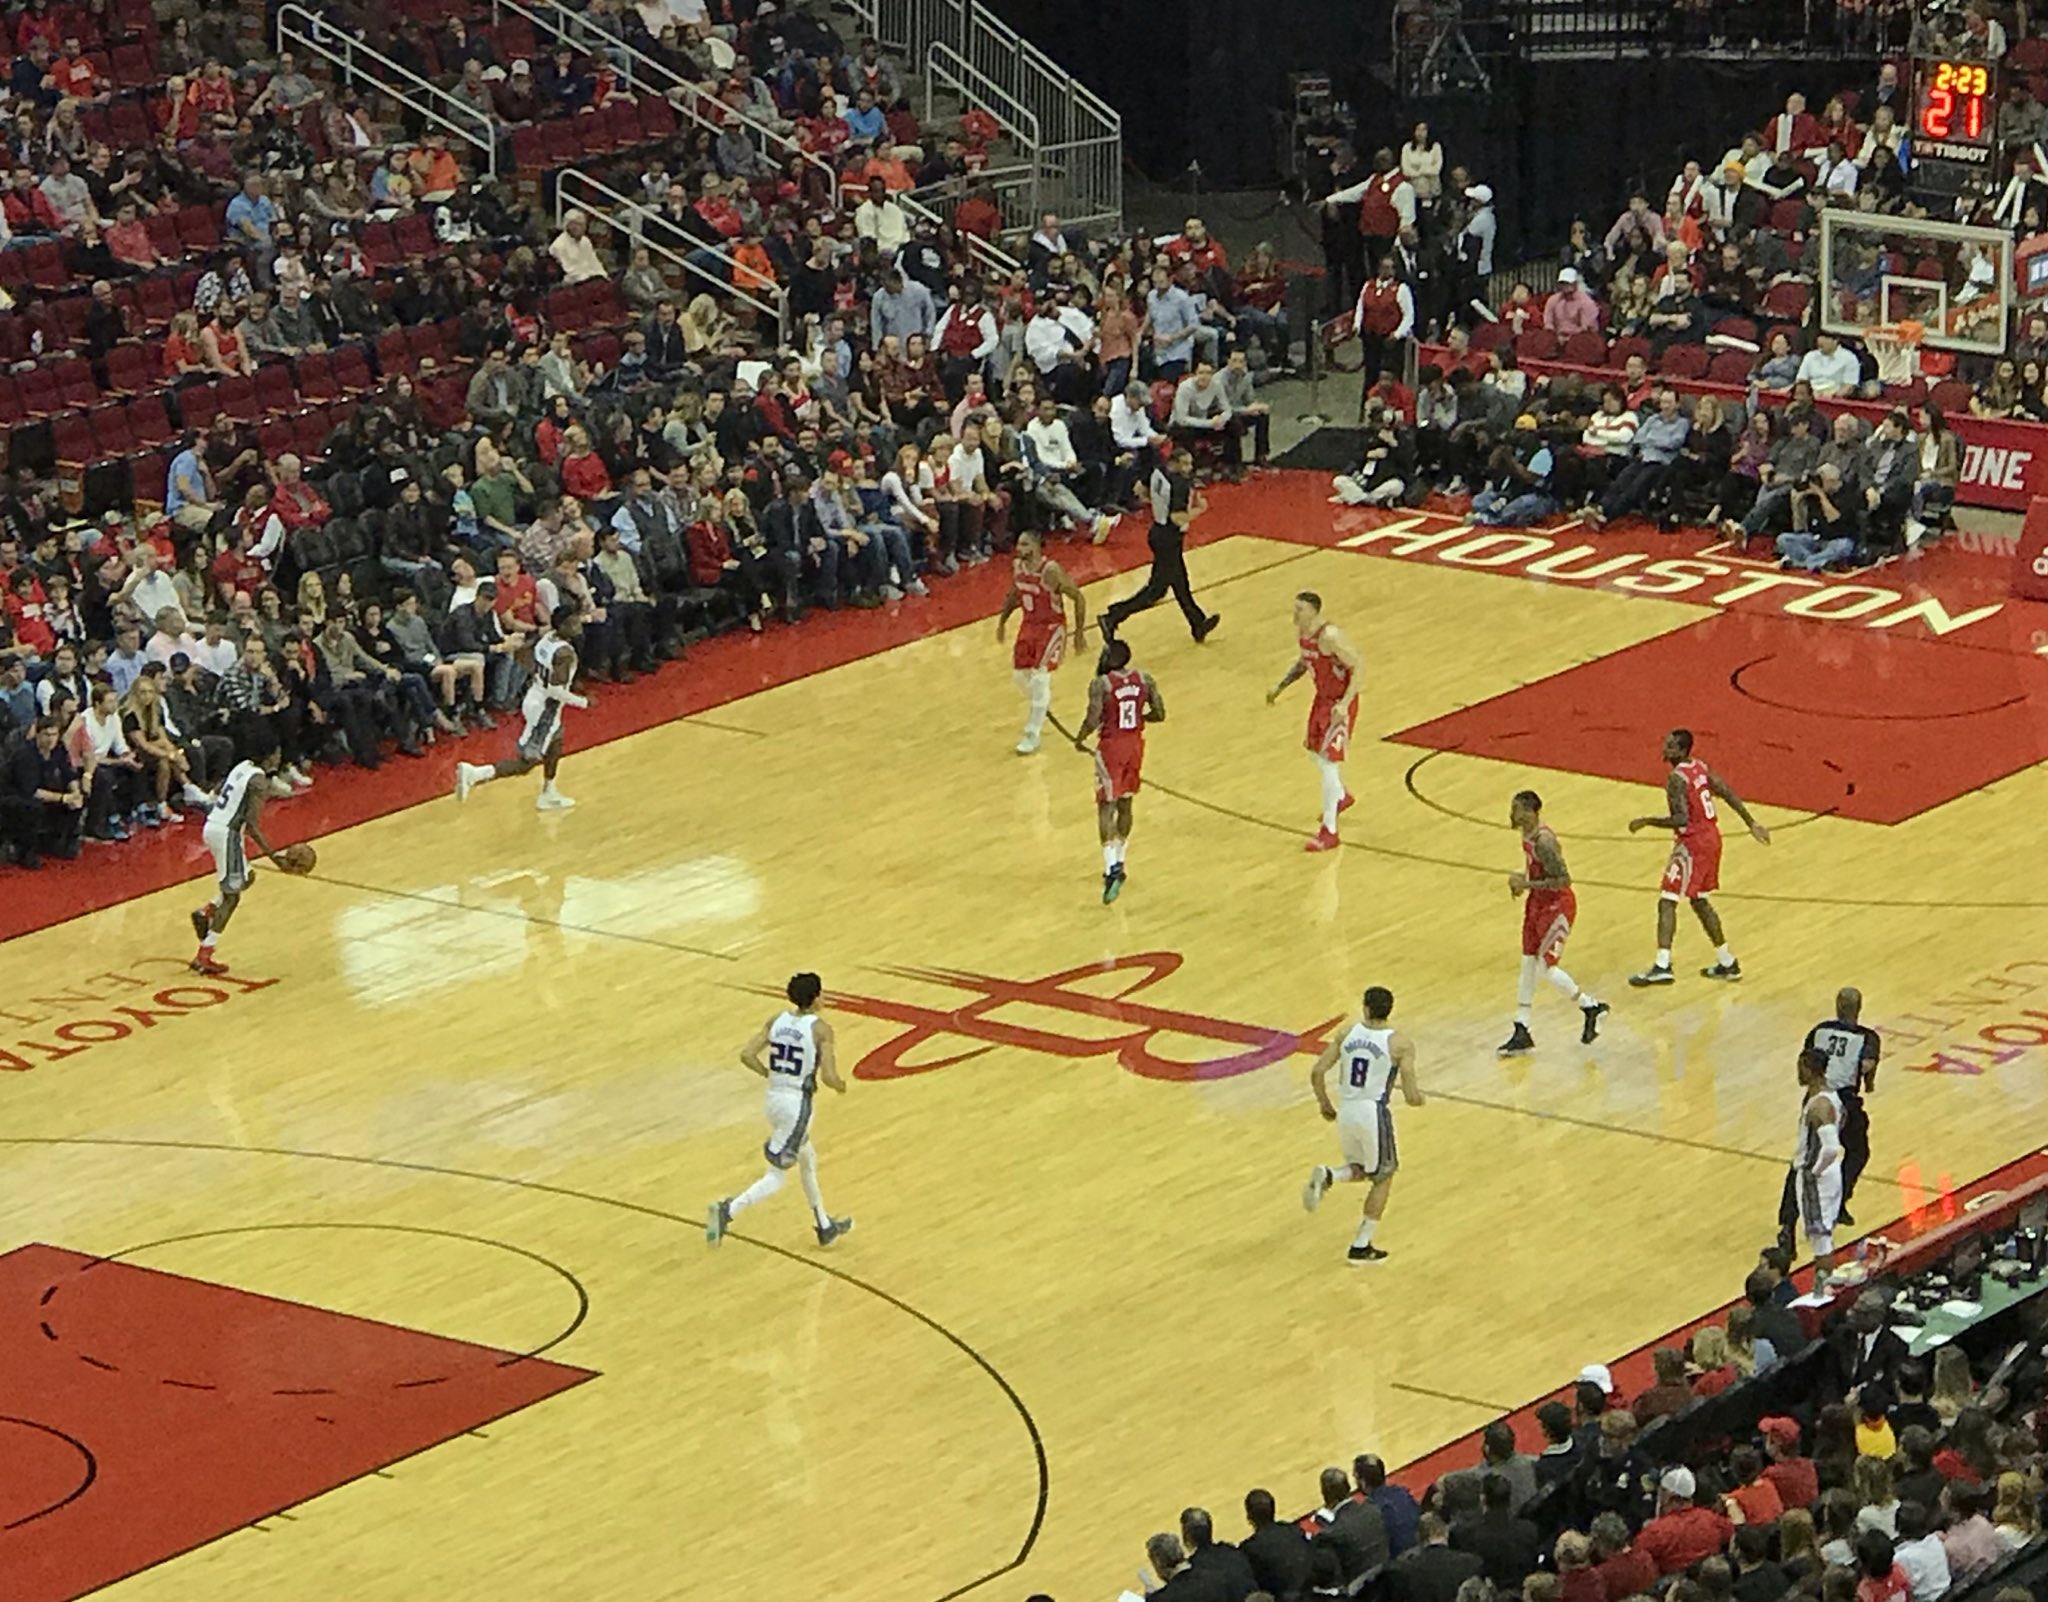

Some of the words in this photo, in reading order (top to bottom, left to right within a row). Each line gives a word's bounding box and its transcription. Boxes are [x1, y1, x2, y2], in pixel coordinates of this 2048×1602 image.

[1936, 63, 1987, 96] 2:23
[1924, 88, 1982, 138] 21
[1337, 517, 2004, 636] HOUSTON
[1118, 700, 1137, 729] 13
[769, 1042, 804, 1076] 25
[1826, 1035, 1849, 1057] 33
[1350, 1056, 1370, 1088] 8
